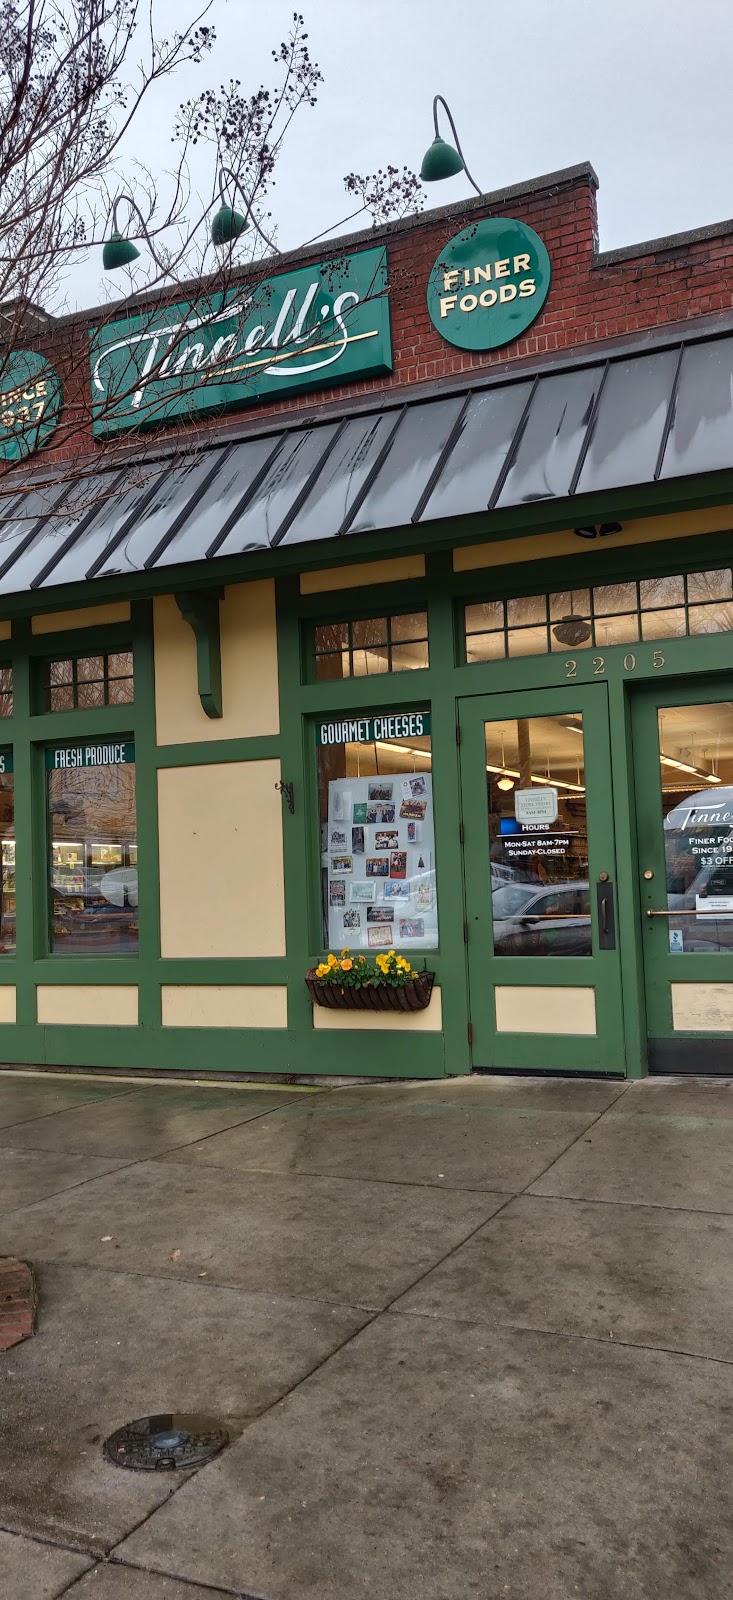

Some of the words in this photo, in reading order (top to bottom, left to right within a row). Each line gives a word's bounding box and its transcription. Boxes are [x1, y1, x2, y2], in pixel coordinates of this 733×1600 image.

[443, 253, 531, 292] FINER
[440, 278, 536, 318] FOODS
[94, 282, 359, 408] Tinnell's
[565, 650, 665, 678] 2205
[320, 719, 371, 745] GOURMET
[373, 714, 424, 740] CHEESES
[54, 748, 82, 768] FRESH
[85, 744, 126, 766] PRODUCE
[508, 848, 566, 856] SUNDAY-CLOSED
[537, 839, 569, 847] 8AM-7PM
[688, 837, 716, 845] FINER
[700, 856, 713, 865] $3
[715, 856, 733, 865] OFF
